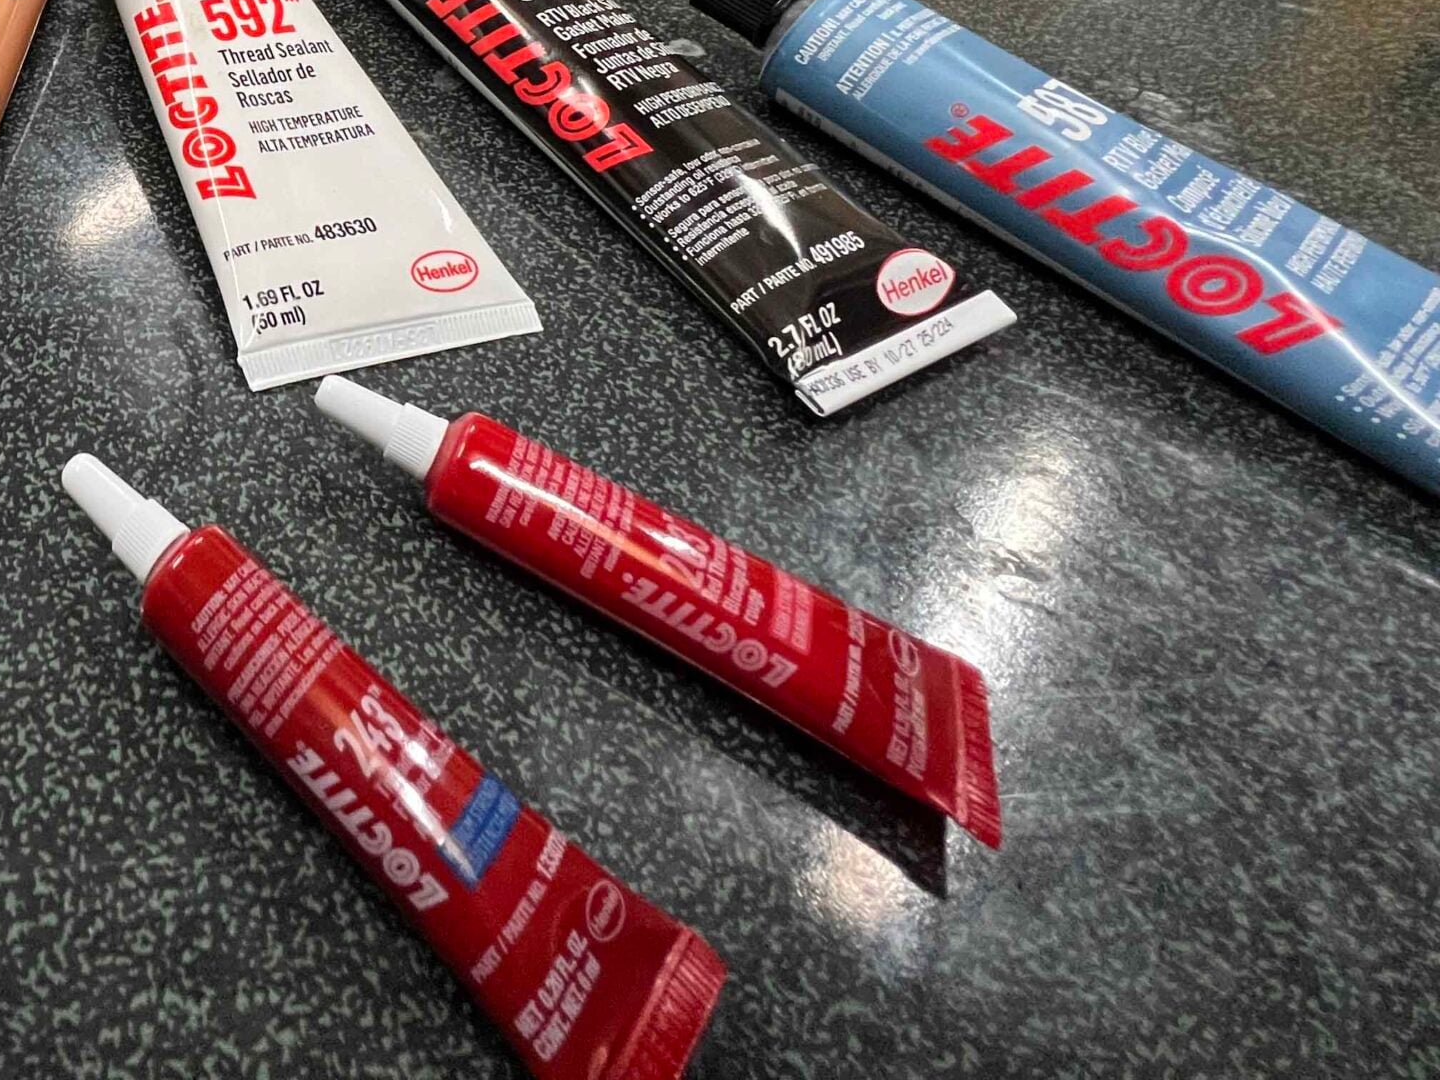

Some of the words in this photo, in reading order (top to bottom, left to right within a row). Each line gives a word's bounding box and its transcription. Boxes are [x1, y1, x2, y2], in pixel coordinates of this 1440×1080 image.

[536, 7, 570, 28] RTV
[567, 0, 600, 21] Black
[553, 19, 601, 42] Gasket
[597, 11, 636, 31] Maker
[218, 44, 276, 67] Thread
[278, 39, 335, 58] Sealant
[571, 33, 634, 60] Formador
[634, 28, 652, 43] de
[795, 18, 840, 65] CAUTION!
[595, 48, 643, 74] Juntas
[641, 43, 657, 62] de
[836, 33, 889, 95] ATTENTION
[228, 66, 293, 89] Sellador
[296, 63, 317, 80] de
[607, 71, 640, 92] RTV
[638, 61, 681, 86] Negra
[133, 1, 257, 200] LOCTITE
[236, 89, 294, 109] Roscas
[633, 98, 666, 116] HIGH
[248, 118, 278, 134] HIGH
[278, 105, 364, 131] TEMPERATURE
[649, 107, 681, 129] ALTO
[258, 137, 288, 153] ALTA
[289, 123, 376, 150] TEMPERATURA
[1102, 134, 1140, 173] RTV
[682, 159, 701, 172] low
[644, 178, 694, 215] Outstanding
[652, 199, 681, 224] Works
[667, 210, 700, 239] Segura
[699, 200, 719, 217] para
[676, 209, 728, 248] Resistencia
[686, 226, 727, 257] Funciona
[726, 212, 751, 235] hasta
[924, 114, 1346, 357] LOCTITE
[223, 242, 252, 262] PART
[260, 235, 295, 251] PARTE
[295, 233, 313, 245] NO.
[314, 217, 378, 242] 483630
[695, 227, 750, 266] intermitente
[416, 259, 473, 283] Henkel
[730, 288, 760, 315] PART
[763, 265, 801, 292] PARTE
[810, 230, 865, 266] 491985
[881, 263, 948, 304] Henkel
[242, 289, 279, 311] 1.69
[280, 284, 301, 303] FL
[301, 279, 325, 298] OZ
[279, 305, 306, 326] ml)
[768, 323, 801, 358] 2.7
[799, 312, 822, 338] FL
[821, 302, 842, 327] OZ
[812, 331, 843, 364] mL)
[845, 367, 867, 382] USE
[863, 357, 881, 375] BY
[884, 339, 919, 366] 10/27
[916, 317, 955, 348] 25/224
[621, 577, 798, 688] LOCTITE
[286, 747, 449, 911] LOCTITE
